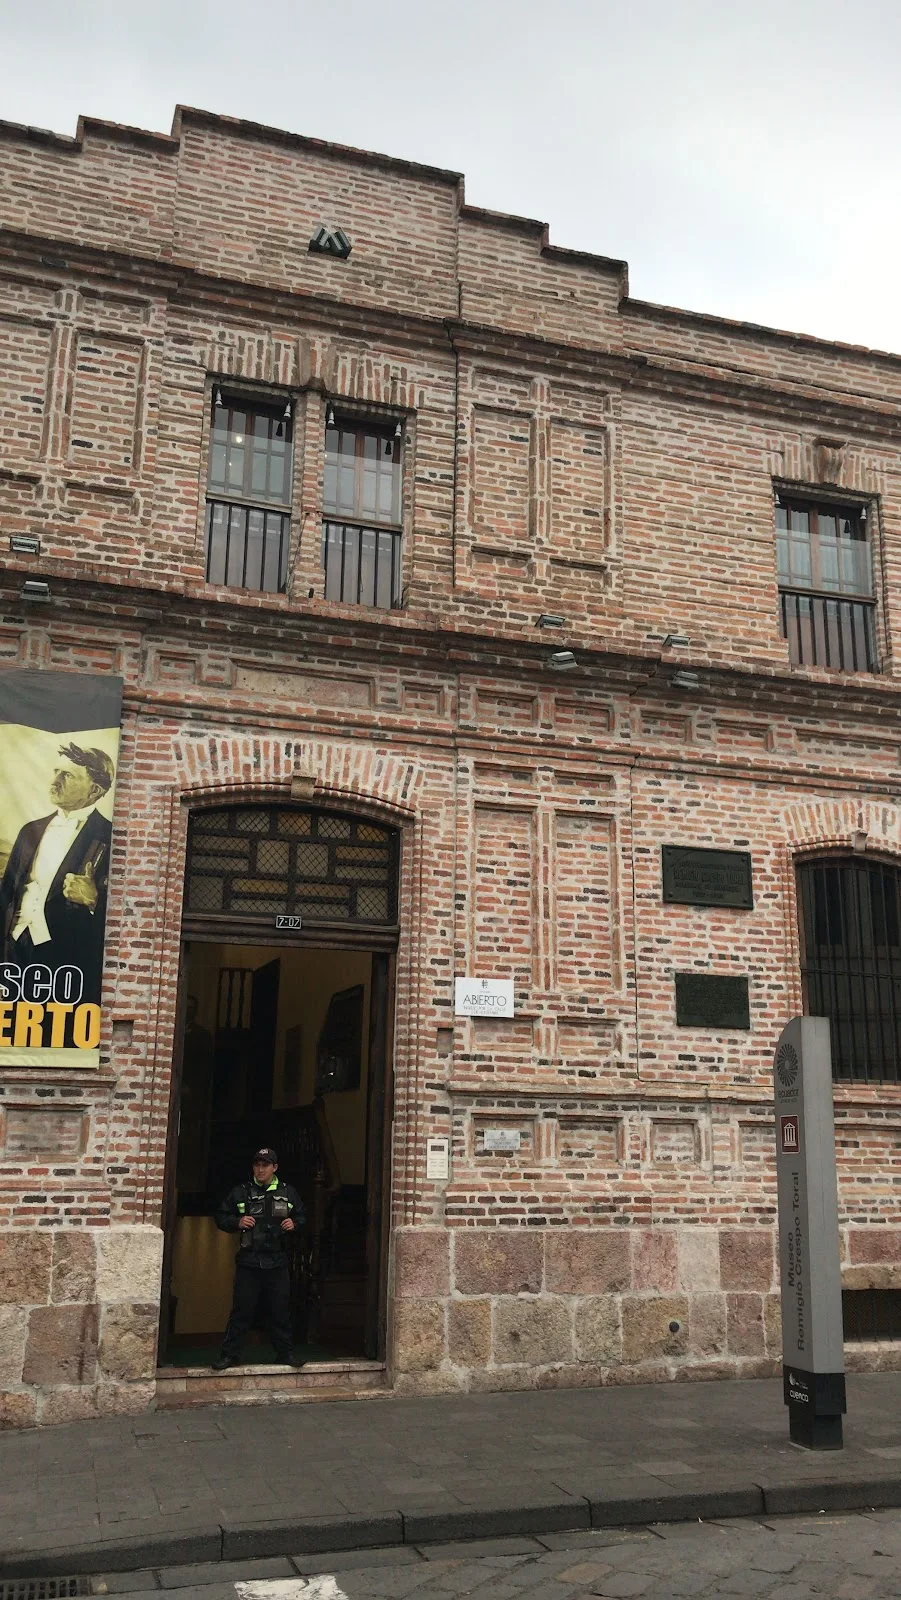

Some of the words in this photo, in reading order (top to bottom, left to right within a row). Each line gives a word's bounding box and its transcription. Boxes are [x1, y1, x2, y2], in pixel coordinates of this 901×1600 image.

[463, 994, 507, 1006] ABIERTO
[792, 1171, 800, 1212] Toral
[787, 1231, 795, 1287] Museo
[796, 1281, 805, 1351] Remigio
